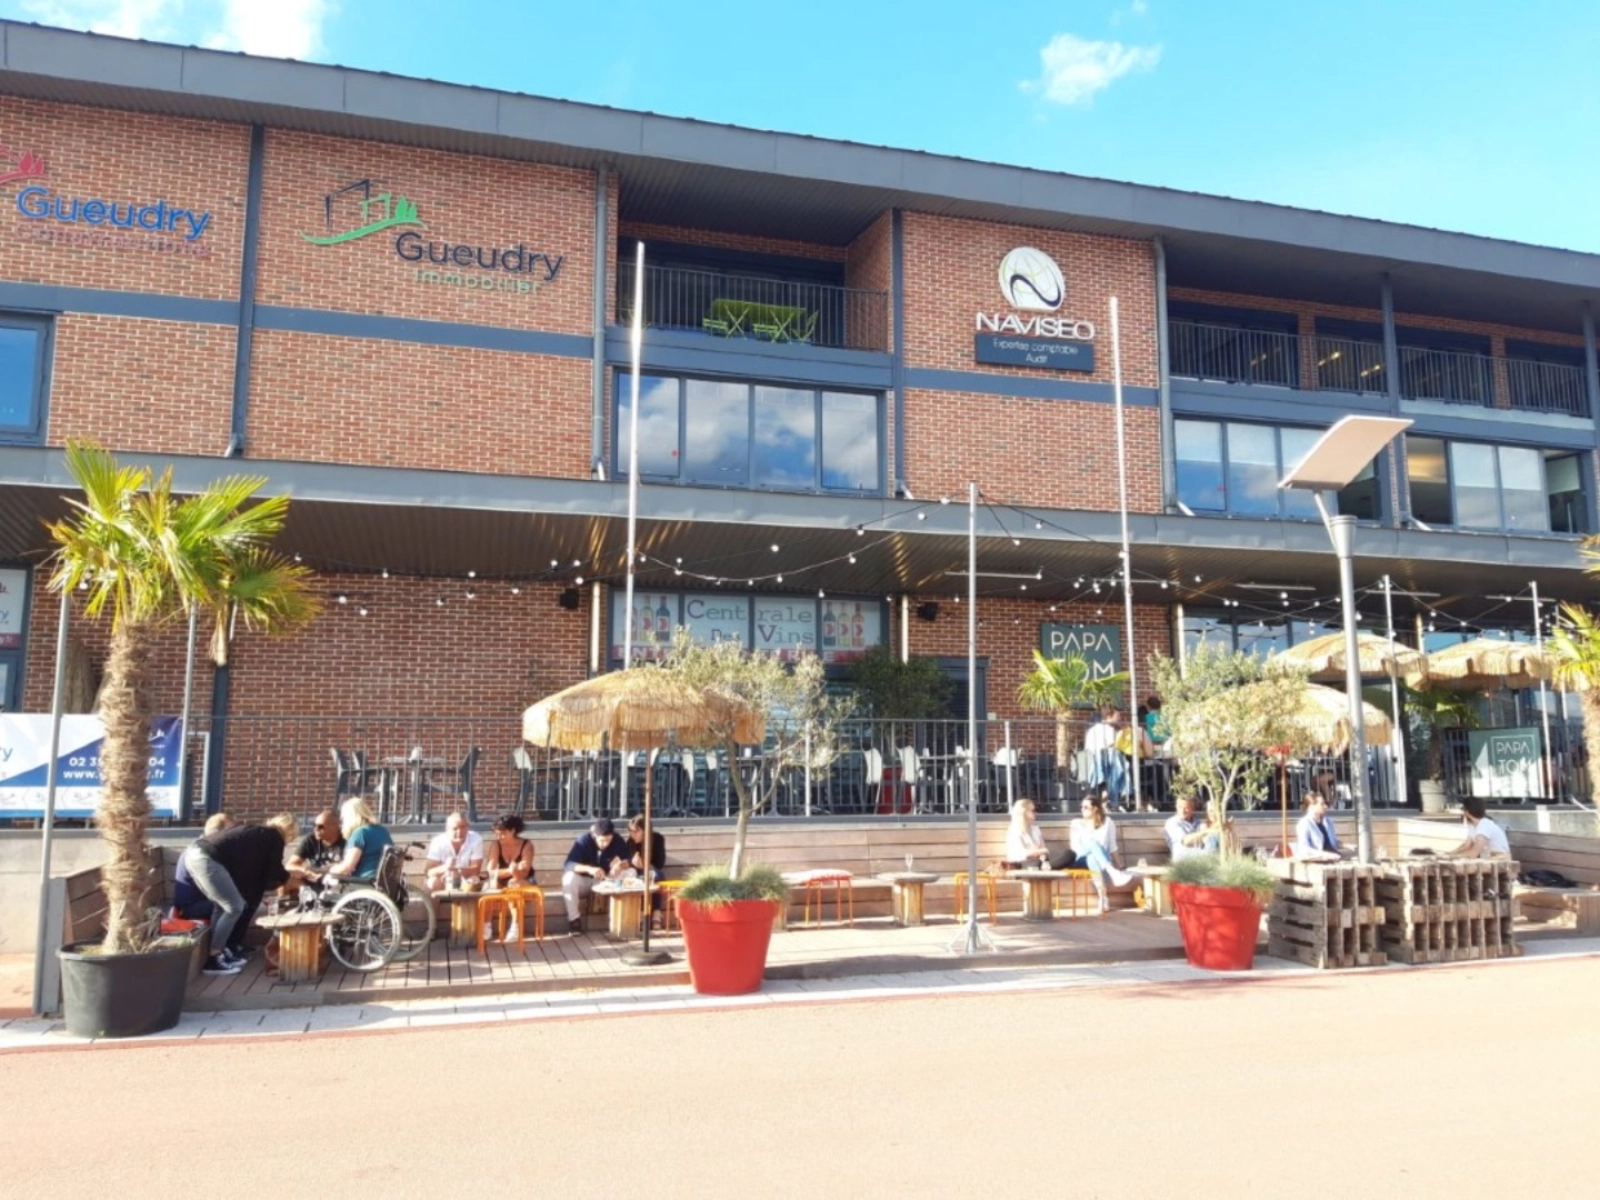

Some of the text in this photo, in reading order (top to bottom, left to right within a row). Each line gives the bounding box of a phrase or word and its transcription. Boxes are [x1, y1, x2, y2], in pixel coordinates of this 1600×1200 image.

[16, 185, 210, 241] Gueudry
[395, 231, 564, 281] Gueudry
[975, 311, 1096, 340] NAVISEO
[993, 337, 1079, 355] Expertise comptable
[1026, 353, 1048, 364] Audit
[757, 624, 814, 643] Vins
[1050, 630, 1112, 652] PAPA
[1496, 741, 1530, 755] PAPA
[69, 757, 86, 767] 02
[148, 757, 165, 767] 04
